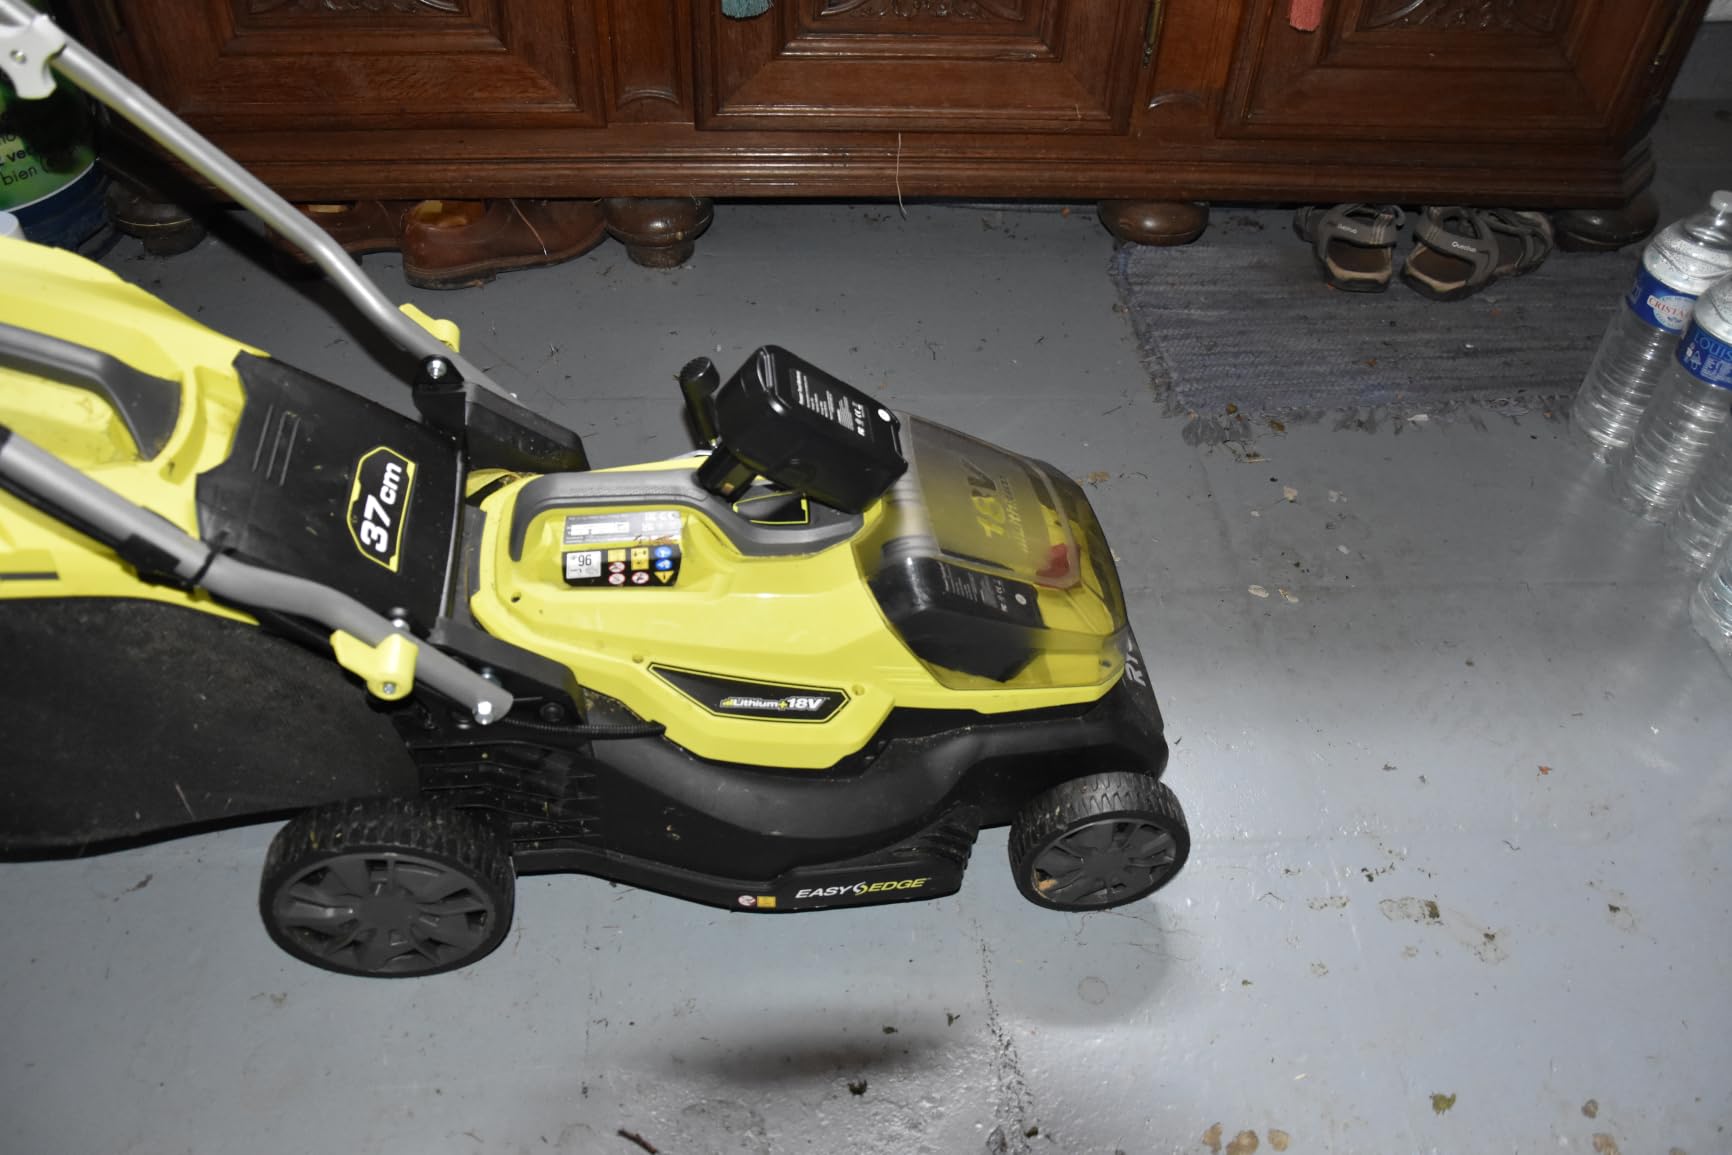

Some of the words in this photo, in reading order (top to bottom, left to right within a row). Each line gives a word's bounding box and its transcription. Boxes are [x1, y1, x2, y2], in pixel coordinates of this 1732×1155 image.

[0, 167, 37, 186] bien
[1648, 297, 1687, 320] CRISTA
[578, 554, 592, 567] 96
[795, 885, 852, 899] EASY
[868, 878, 927, 893] EDGE
